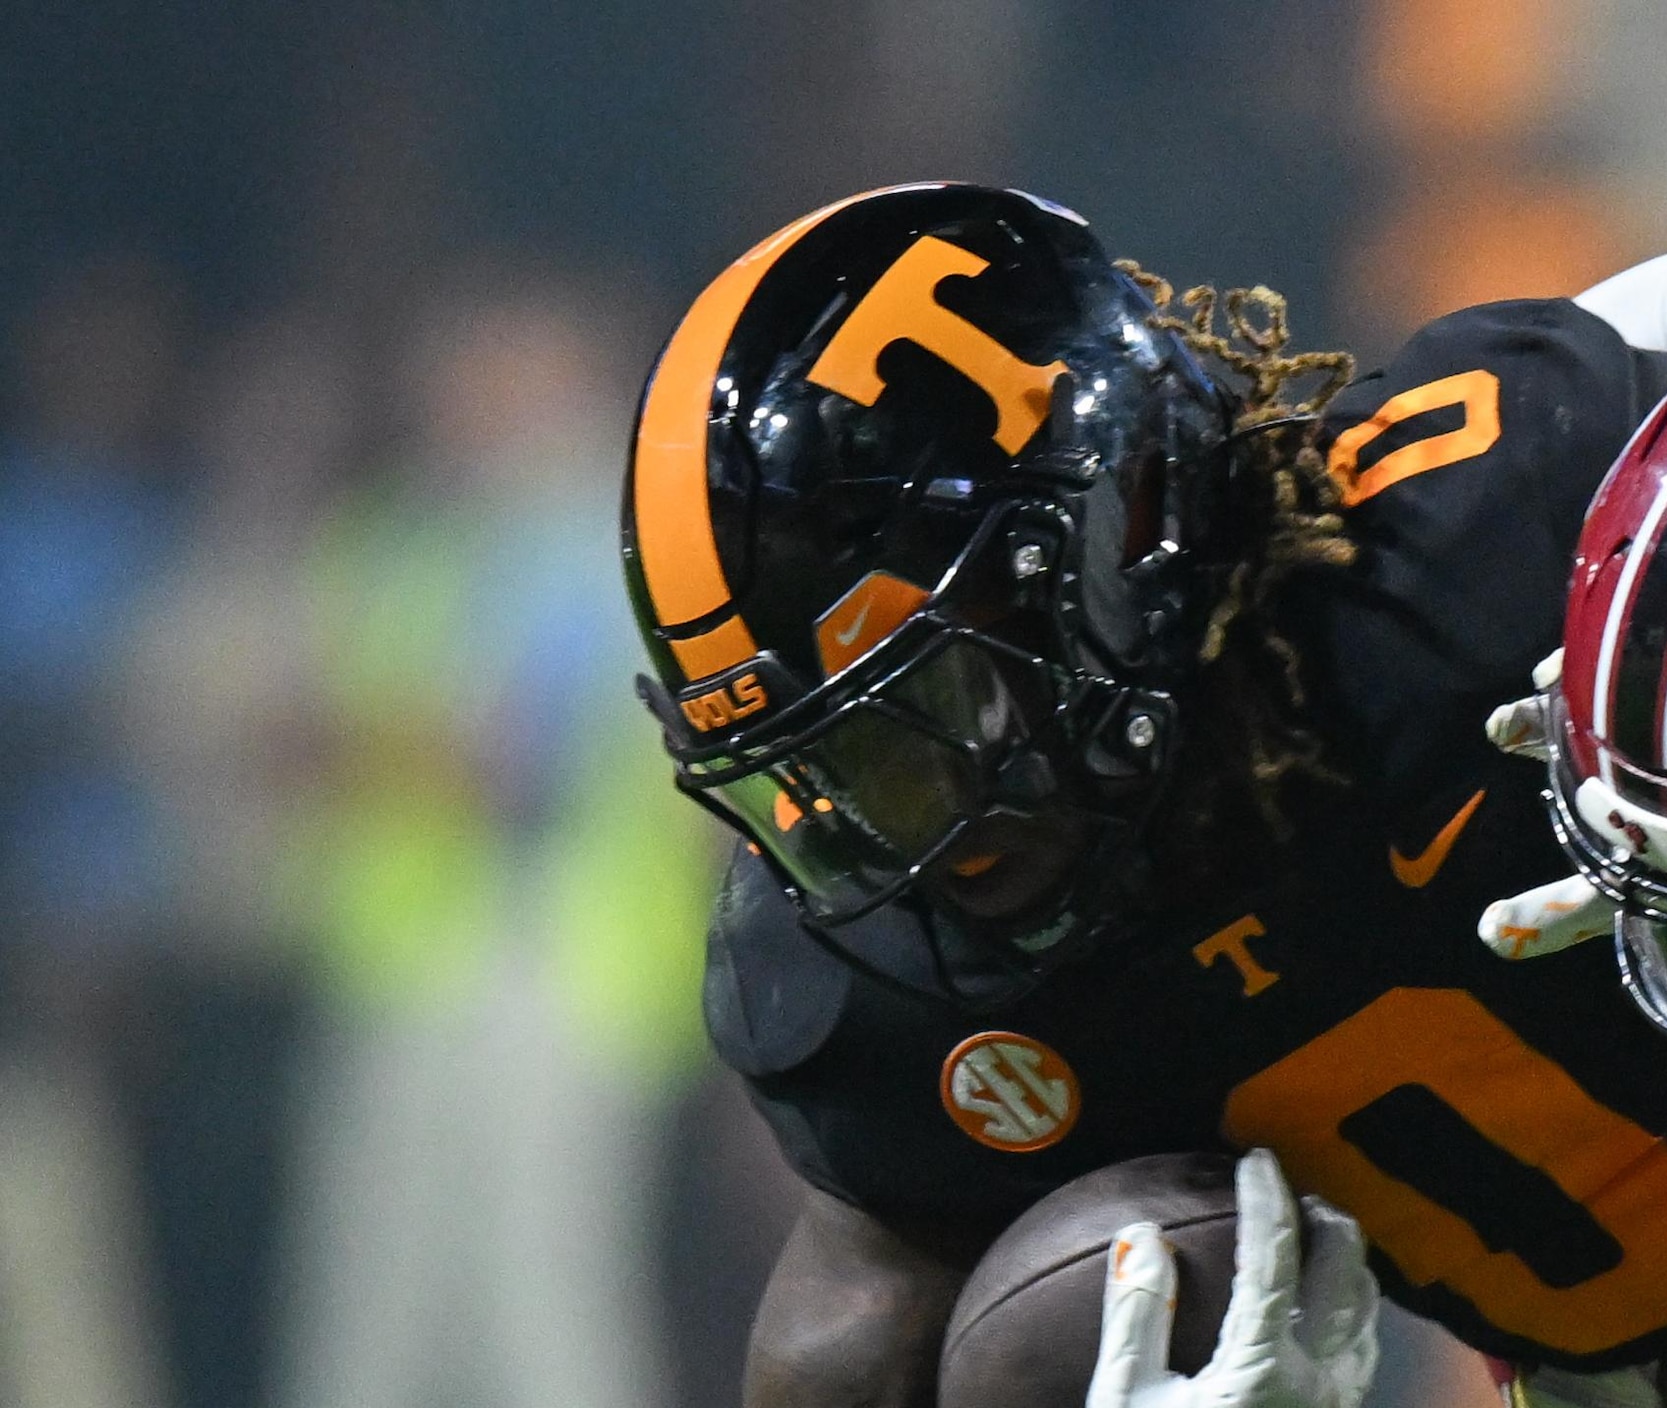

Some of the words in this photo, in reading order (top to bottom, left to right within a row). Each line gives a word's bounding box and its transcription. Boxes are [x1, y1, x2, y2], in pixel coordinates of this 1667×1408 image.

[807, 236, 1069, 457] T
[1327, 369, 1502, 508] 0
[1193, 912, 1281, 997] T
[952, 1042, 1069, 1142] SEC
